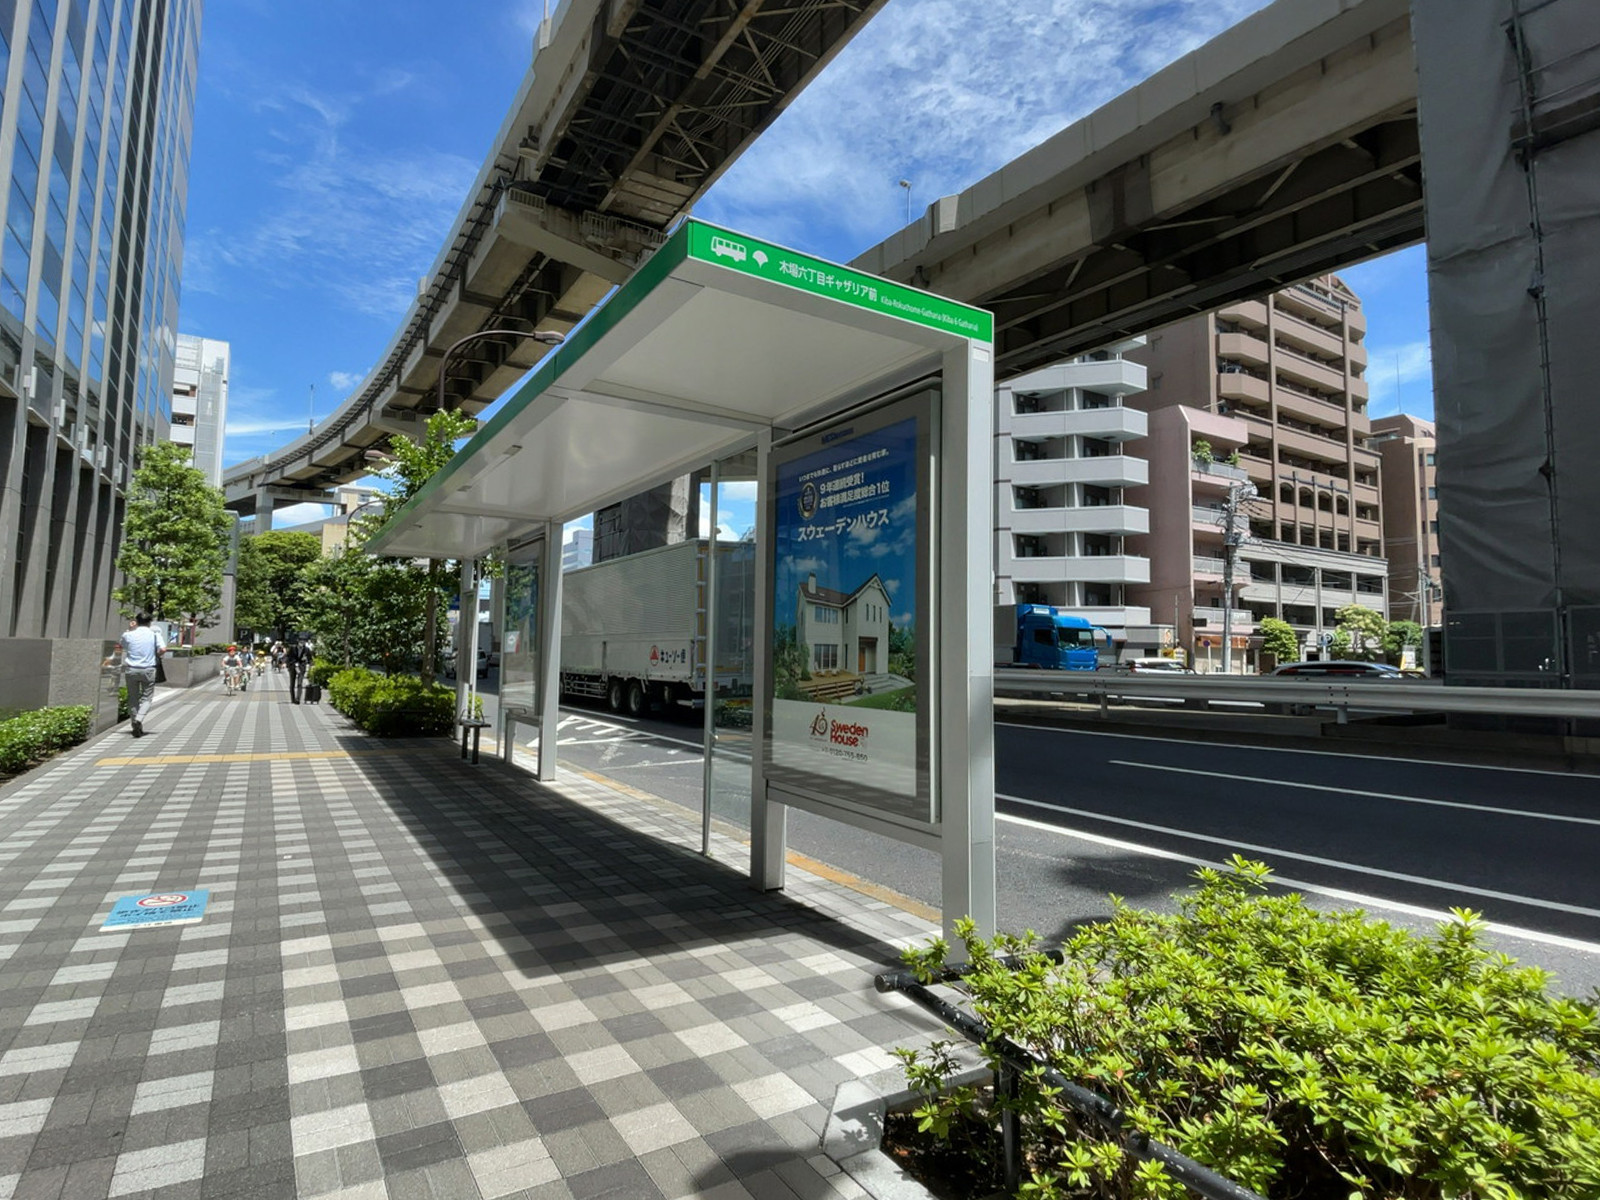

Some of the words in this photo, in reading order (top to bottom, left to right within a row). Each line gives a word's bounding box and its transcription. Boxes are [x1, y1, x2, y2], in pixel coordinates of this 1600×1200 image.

[779, 260, 877, 302] 木場六丁目ギャザリア前
[798, 509, 889, 541] スウェーデンハウス
[830, 720, 869, 738] Sweden
[830, 729, 858, 747] House
